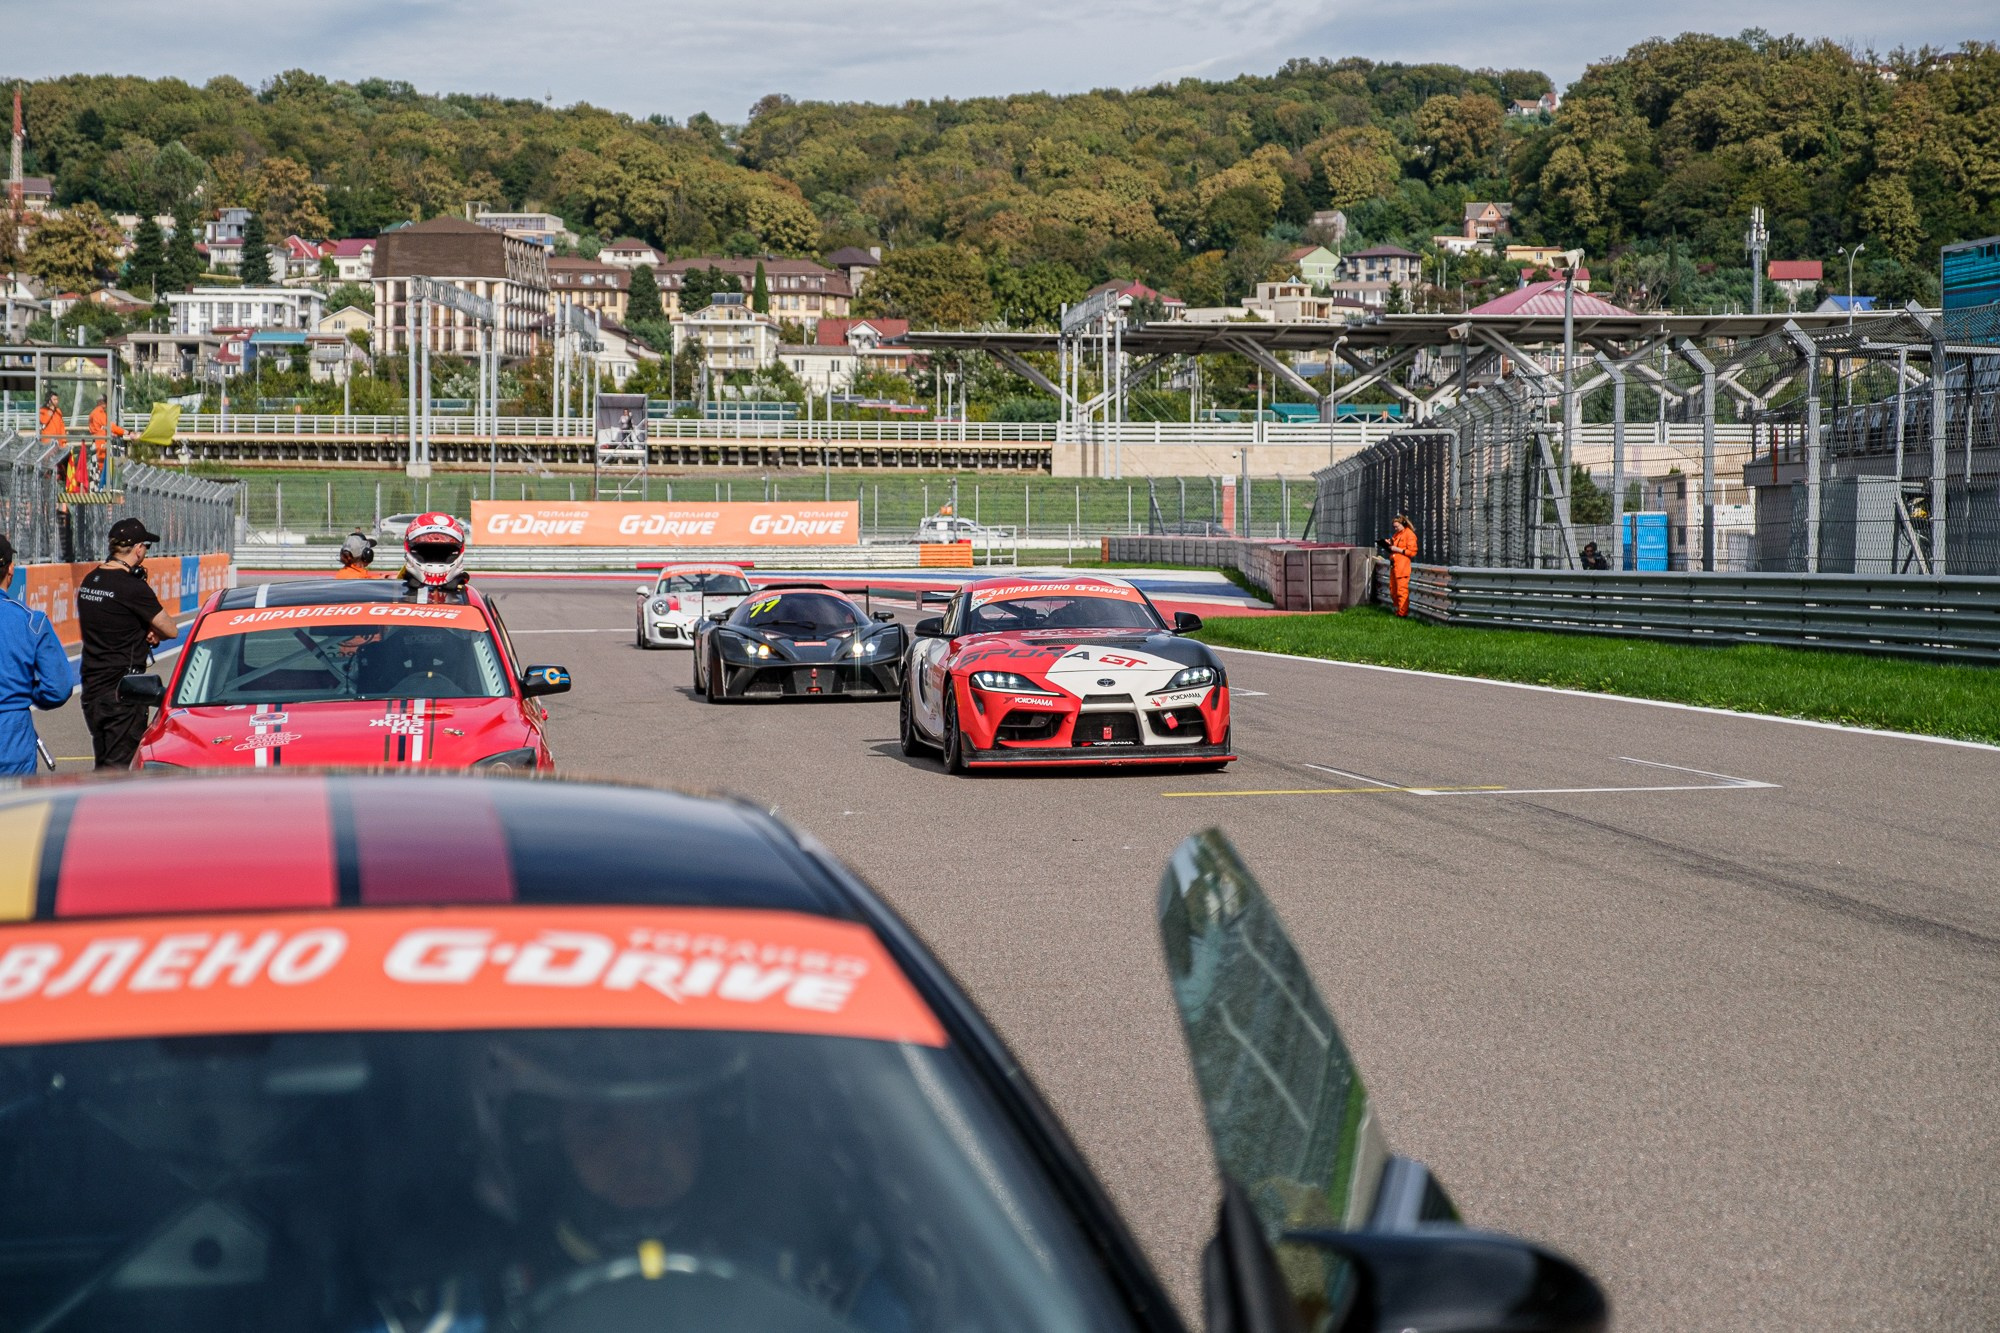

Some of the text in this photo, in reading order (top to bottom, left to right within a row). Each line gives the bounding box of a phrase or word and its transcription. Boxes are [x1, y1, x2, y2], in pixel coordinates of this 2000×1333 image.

[90, 589, 115, 598] KARTING
[988, 584, 1071, 597] ЗАПРАВЛЕНО
[228, 606, 363, 626] ЗАПРАВЛЕНО
[1098, 654, 1148, 668] GT
[1014, 697, 1054, 707] YOKOHAMA
[1169, 693, 1202, 701] YOKOHAMA
